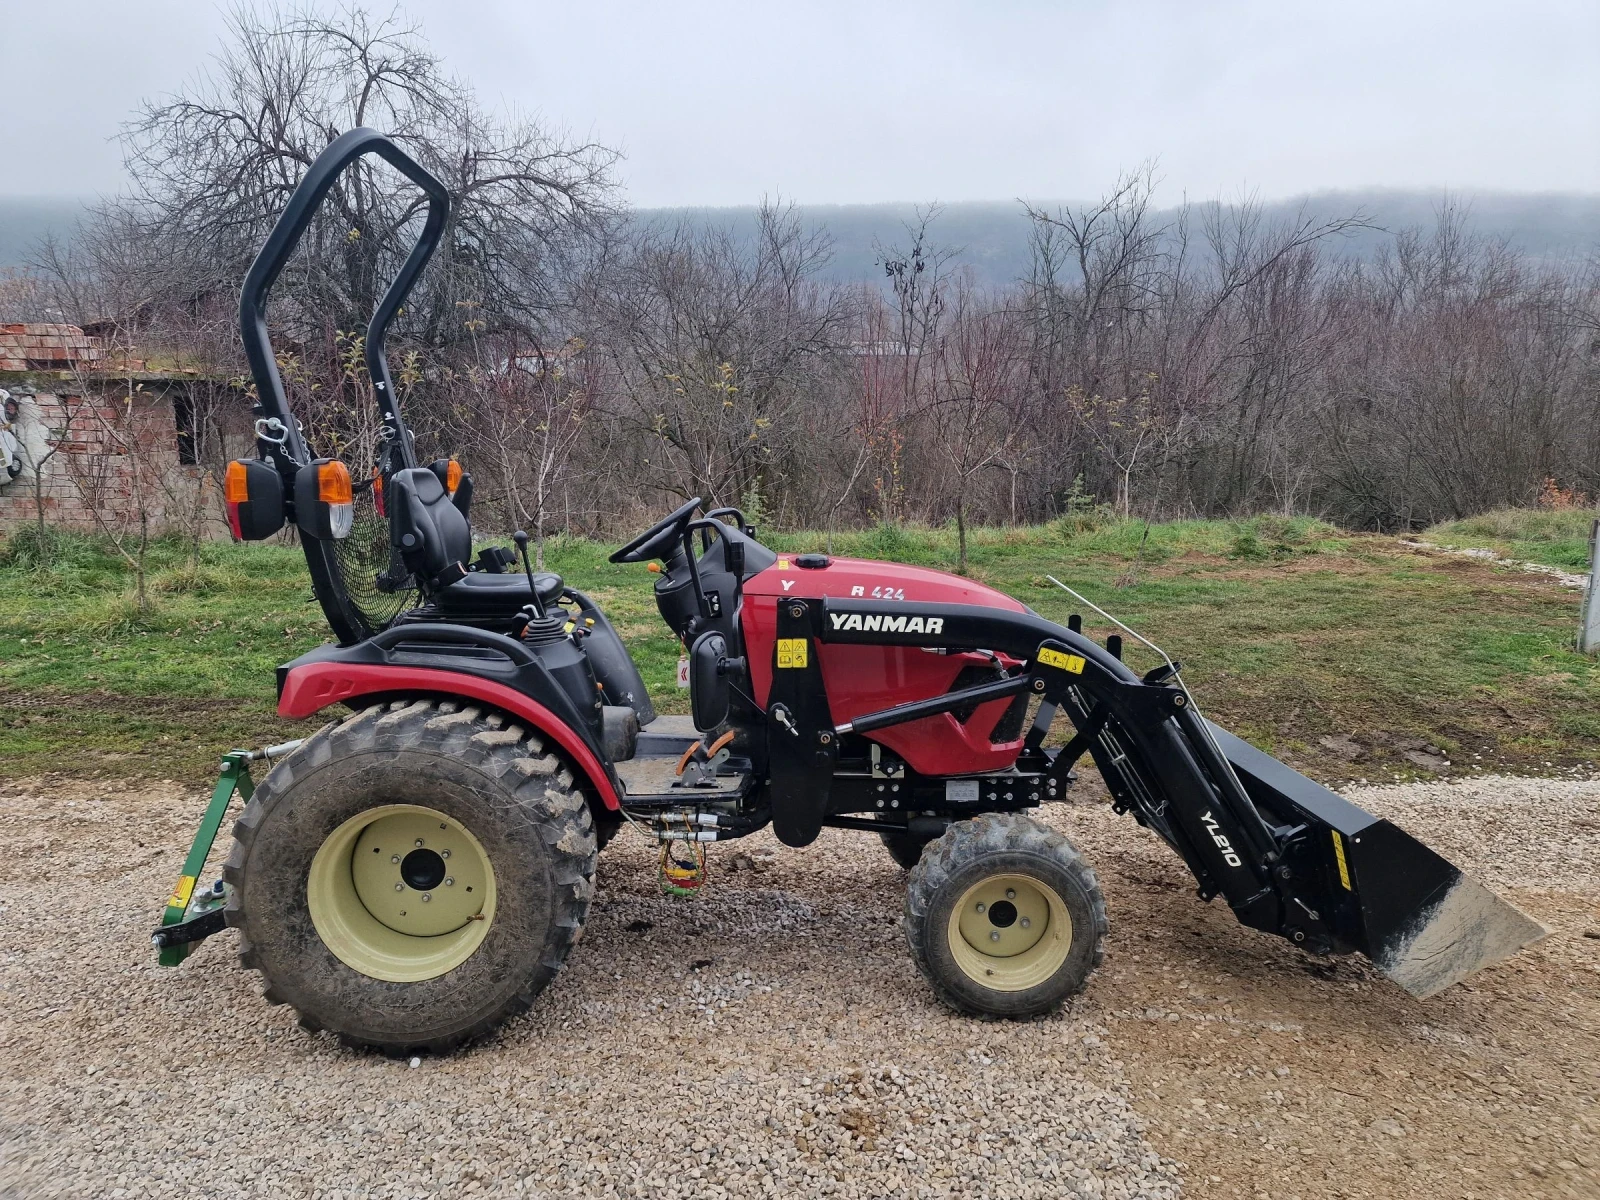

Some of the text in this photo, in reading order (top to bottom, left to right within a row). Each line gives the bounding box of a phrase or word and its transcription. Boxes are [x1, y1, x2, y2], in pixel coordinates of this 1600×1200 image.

[871, 586, 905, 601] 424
[829, 613, 944, 634] YANMAR
[1200, 811, 1242, 867] YL210
